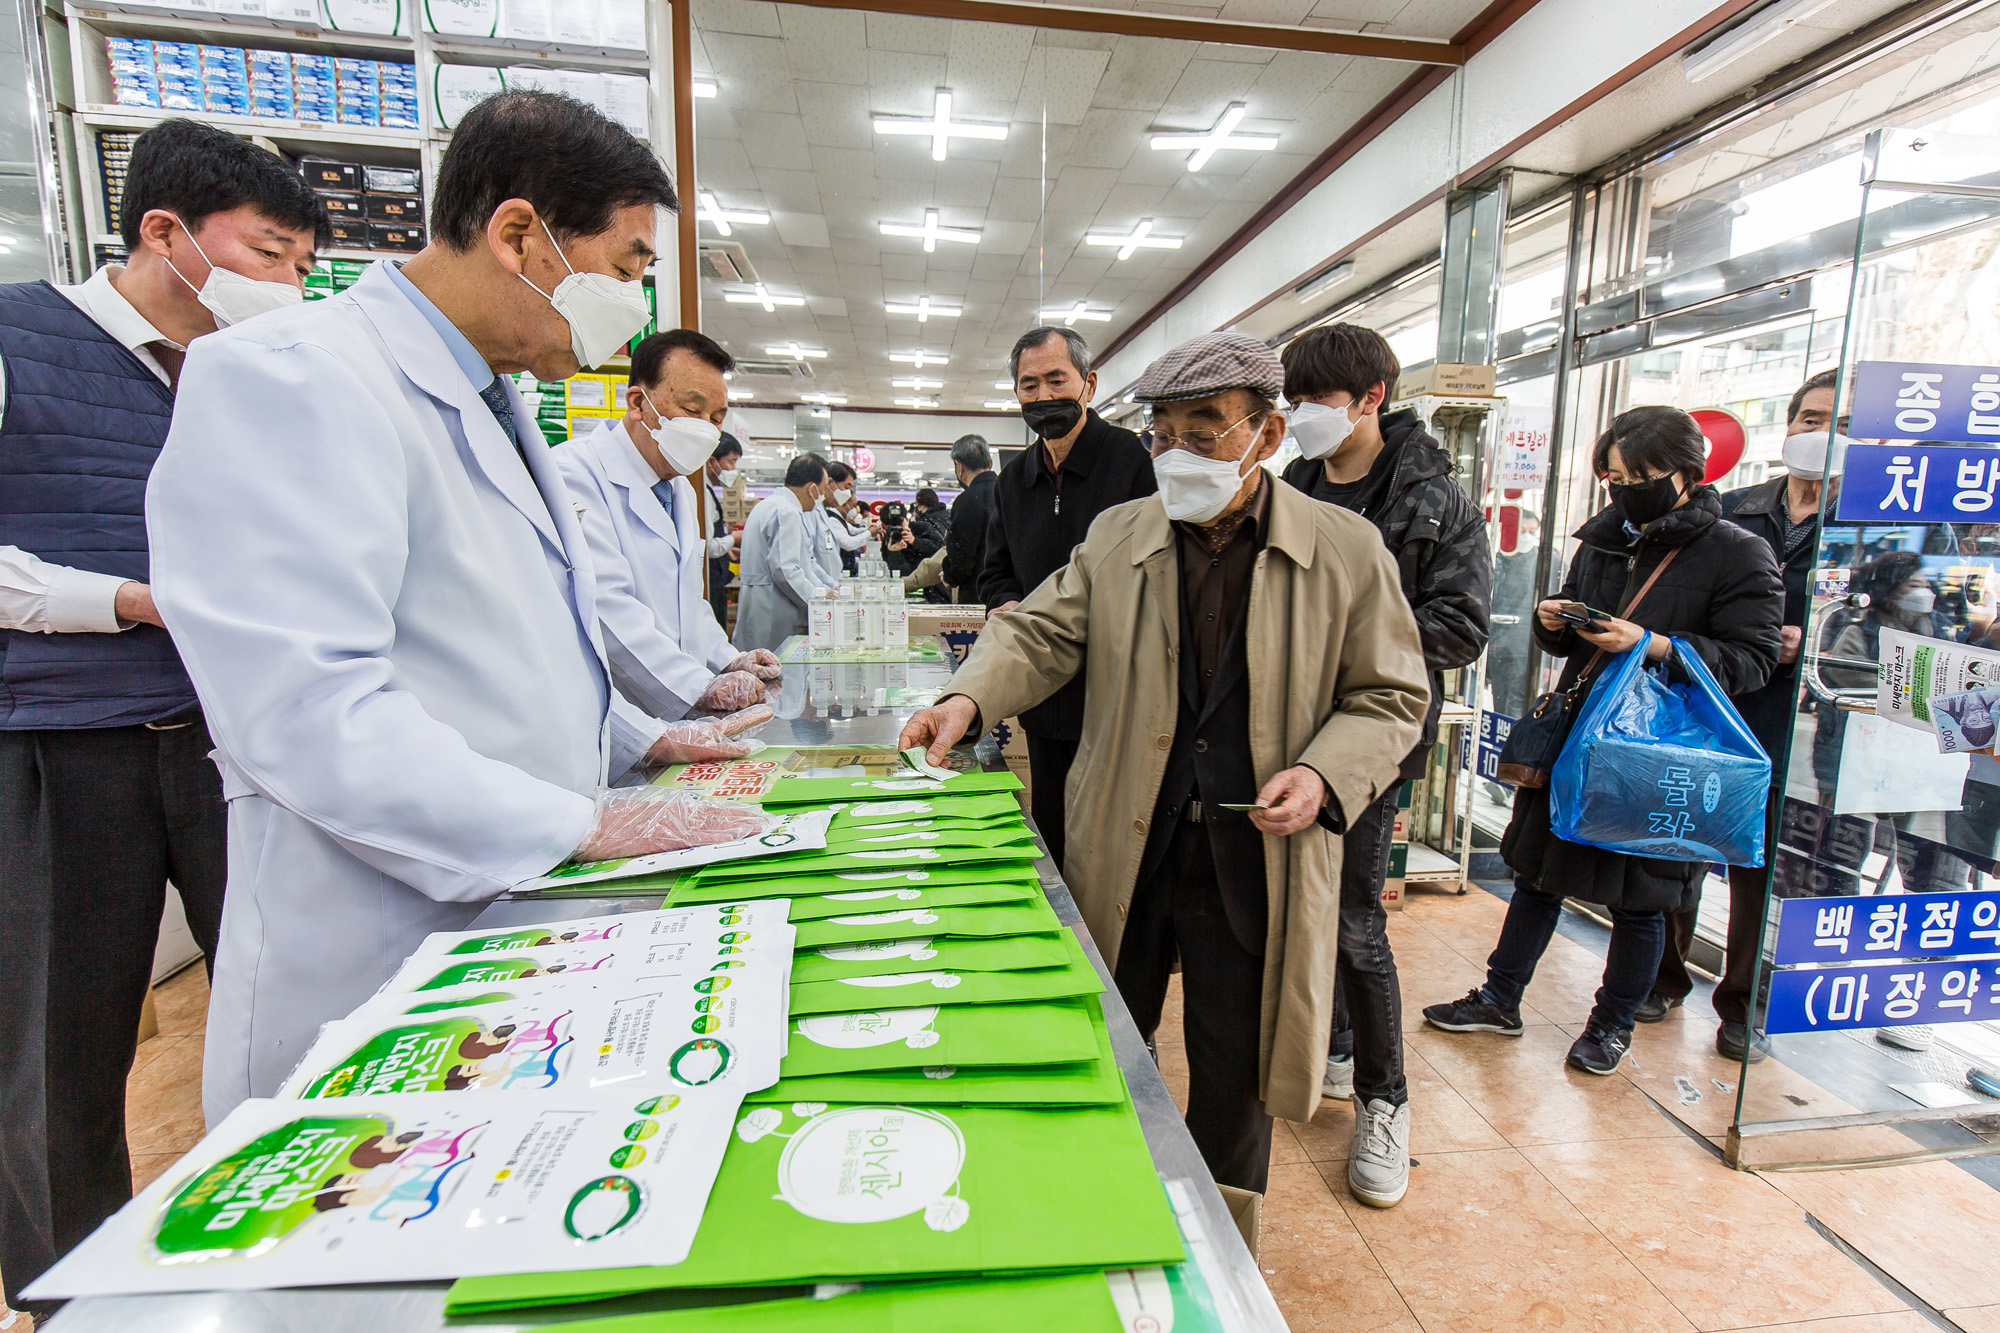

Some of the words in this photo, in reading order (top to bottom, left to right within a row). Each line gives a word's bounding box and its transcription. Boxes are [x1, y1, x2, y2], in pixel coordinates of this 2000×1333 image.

[1879, 455, 2000, 513] 처방
[1895, 645, 1905, 673] 마스크
[1892, 675, 1904, 709] 미세먼지
[1942, 730, 1956, 750] 1000
[712, 761, 776, 797] 탈모예방
[1805, 967, 2000, 1026] (마장약
[603, 1008, 622, 1044] 황사방역마스크
[1610, 1038, 1625, 1053] N
[372, 1031, 430, 1093] 세먼지
[400, 1033, 456, 1094] 마스크
[178, 1158, 248, 1209] KF94
[203, 1128, 337, 1231] 미세먼지
[260, 1135, 358, 1211] 마스크
[859, 1127, 902, 1200] 센시아
